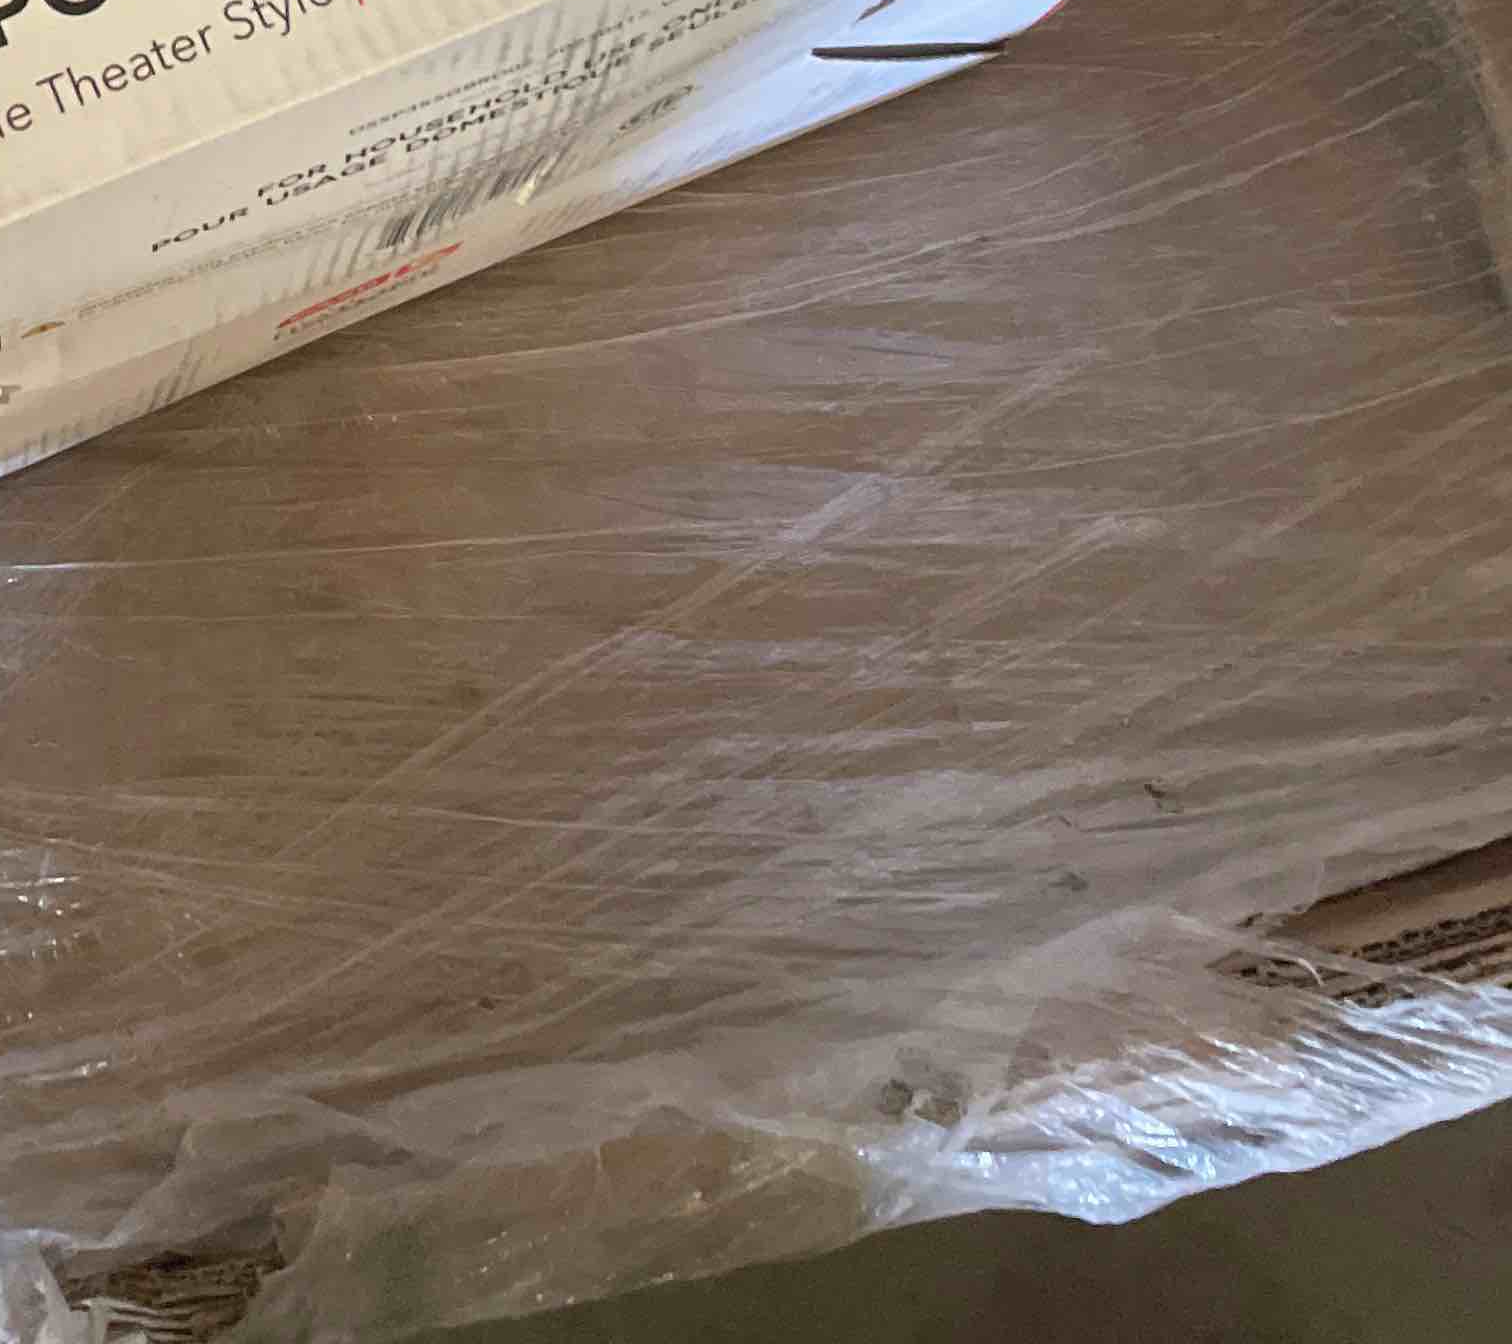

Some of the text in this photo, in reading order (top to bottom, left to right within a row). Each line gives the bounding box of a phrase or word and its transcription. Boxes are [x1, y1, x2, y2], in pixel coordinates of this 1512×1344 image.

[35, 22, 213, 116] Theater
[258, 163, 327, 198] FOR
[345, 69, 568, 163] HOUSEHOLD
[584, 32, 648, 70] USE
[151, 206, 248, 254] POUR
[265, 152, 389, 206] USAGE
[405, 54, 632, 154] DOMESTIQUE
